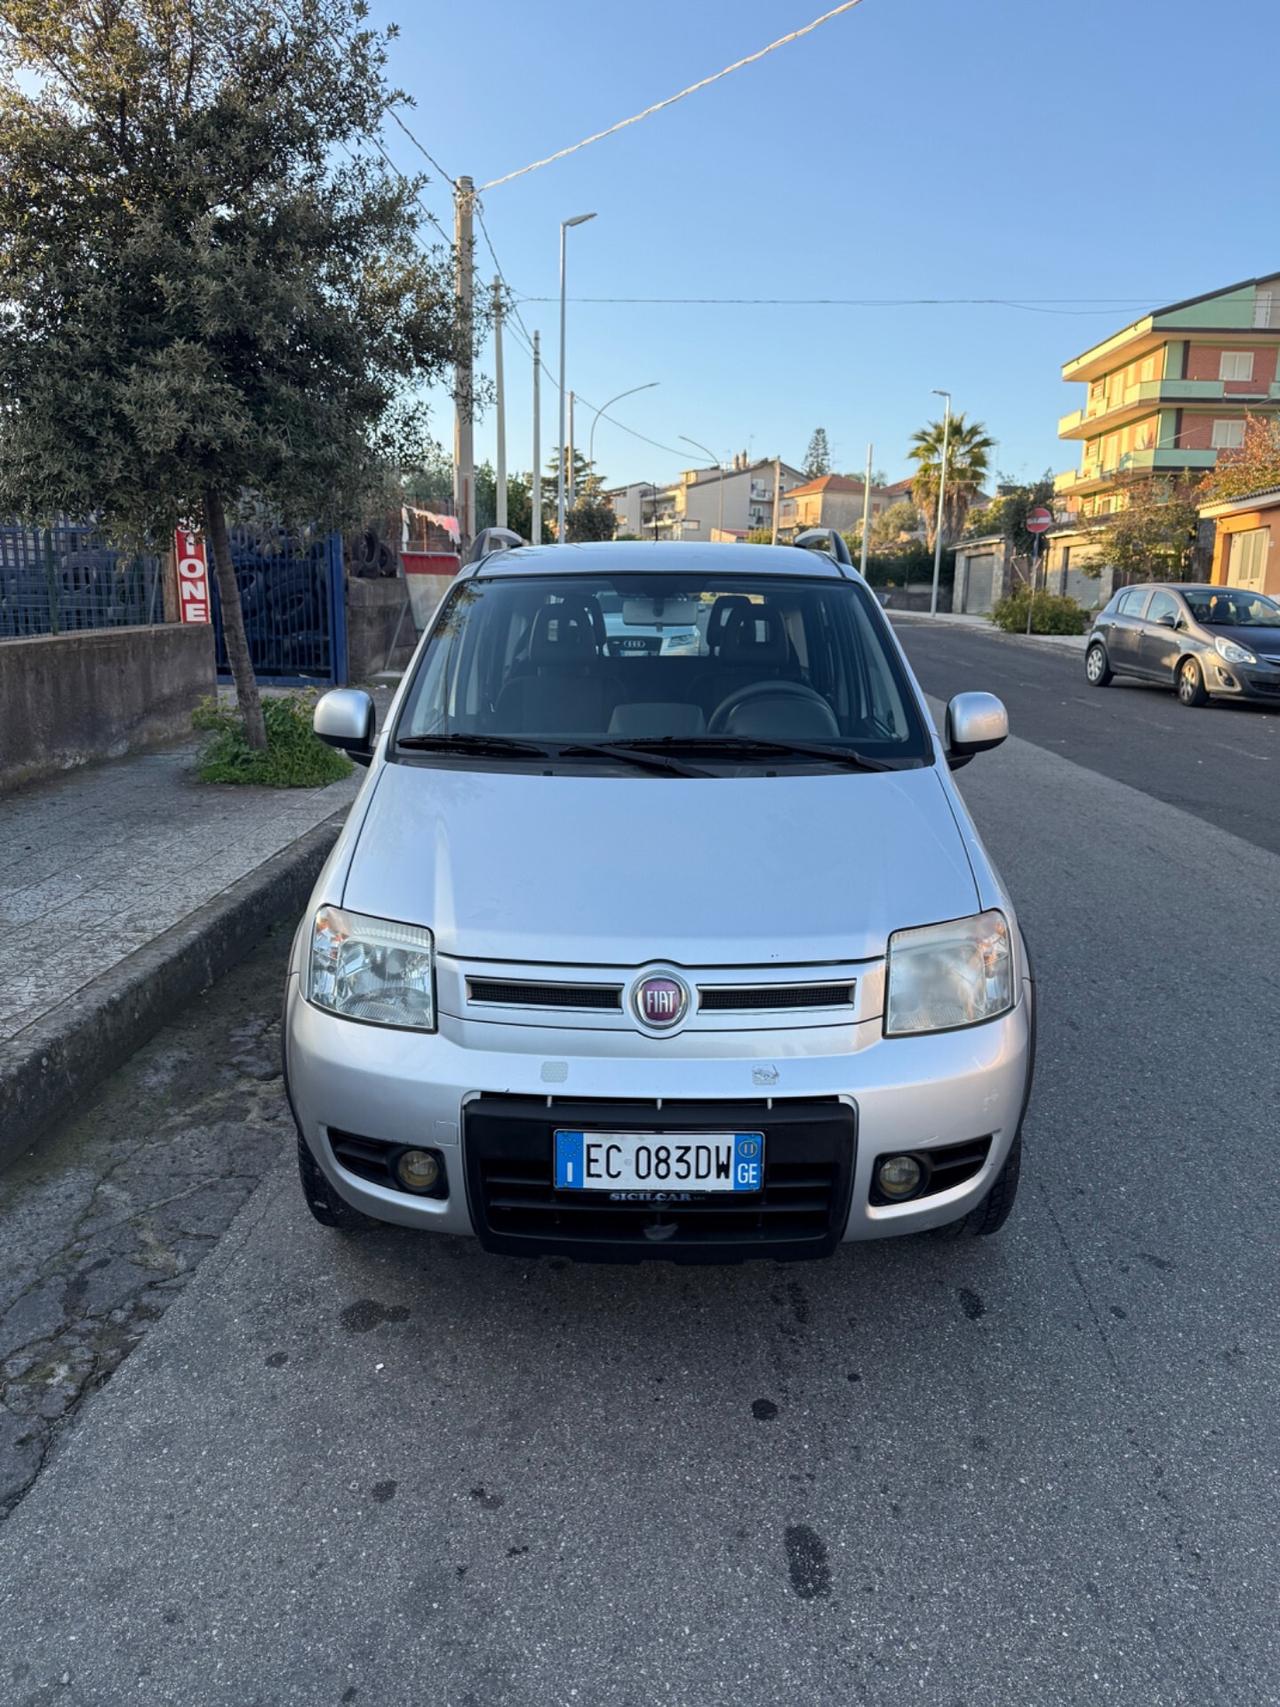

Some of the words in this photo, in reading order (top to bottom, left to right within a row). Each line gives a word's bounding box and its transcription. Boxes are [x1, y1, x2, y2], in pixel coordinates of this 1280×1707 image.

[646, 991, 676, 1013] FIAT
[586, 1144, 622, 1179] EC
[635, 1145, 732, 1180] 083DW
[737, 1163, 758, 1184] GE
[609, 1193, 692, 1202] SICILCAR
